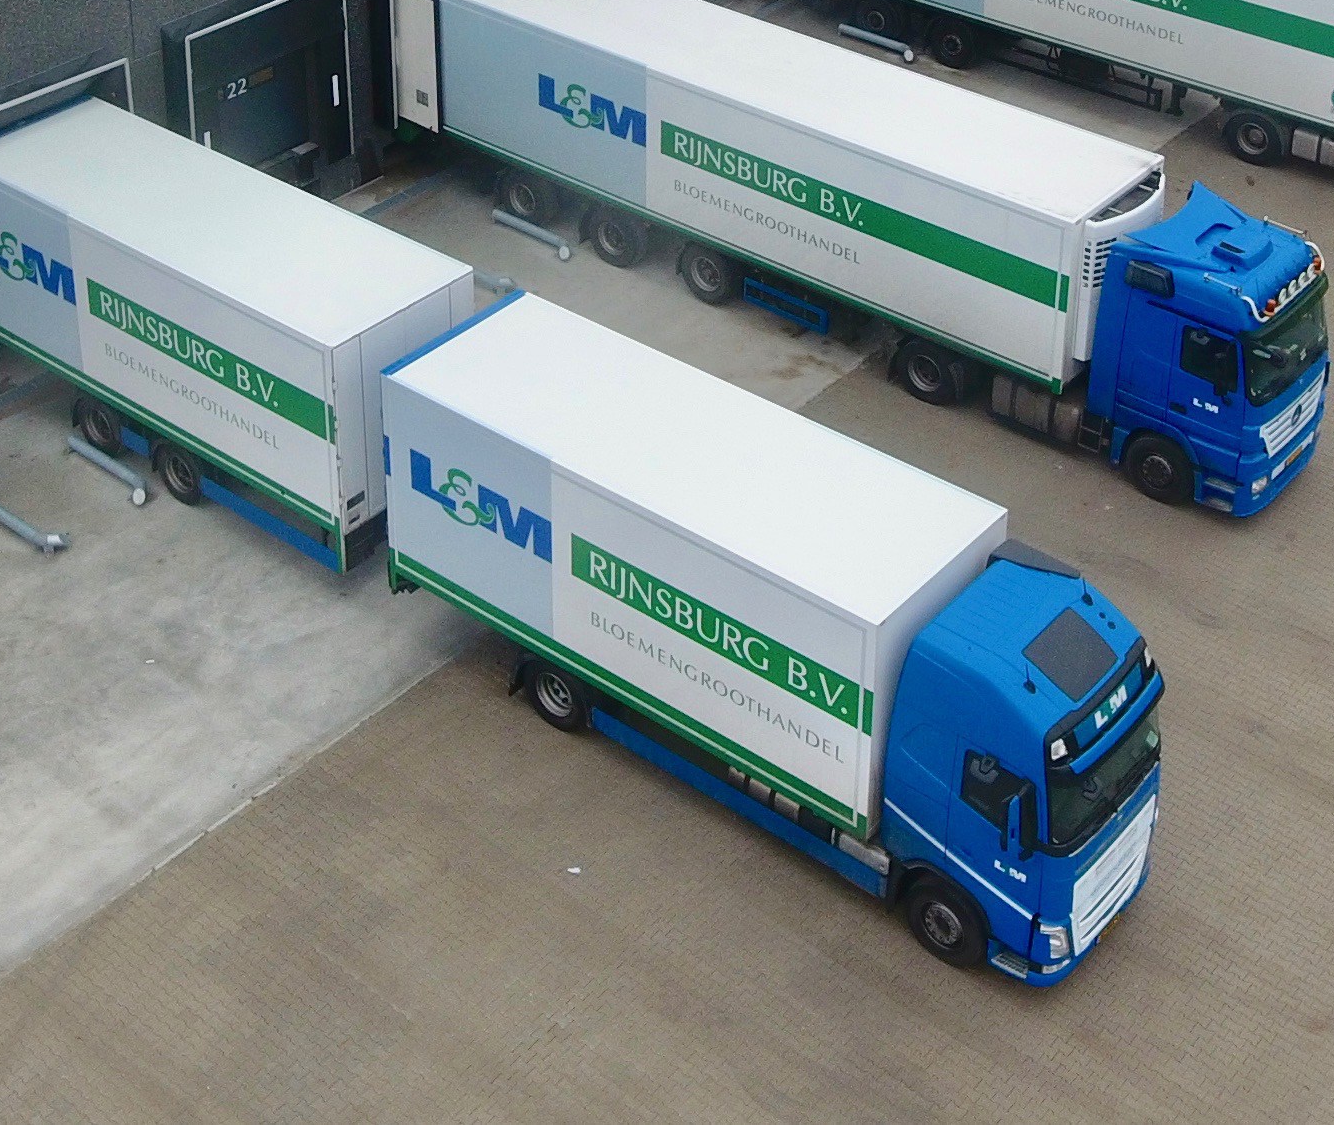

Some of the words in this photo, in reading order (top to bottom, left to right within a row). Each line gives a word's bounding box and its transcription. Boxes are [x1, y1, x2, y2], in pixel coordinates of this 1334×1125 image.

[227, 77, 248, 100] 22
[538, 72, 647, 148] L&M
[673, 131, 807, 204] RIJNSBURG
[818, 187, 864, 227] B.V.
[673, 179, 861, 265] BLOEMENGROOTHANDEL
[99, 290, 225, 379] RIJNSBURG
[234, 363, 280, 408] B.V.
[104, 342, 280, 451] BLOEMENGROOTHANDEL
[409, 447, 553, 565] L&M
[588, 550, 770, 672] RIJNSBURG
[786, 656, 850, 715] B.V.
[590, 611, 846, 765] BLOEMENGROOTHANDEL
